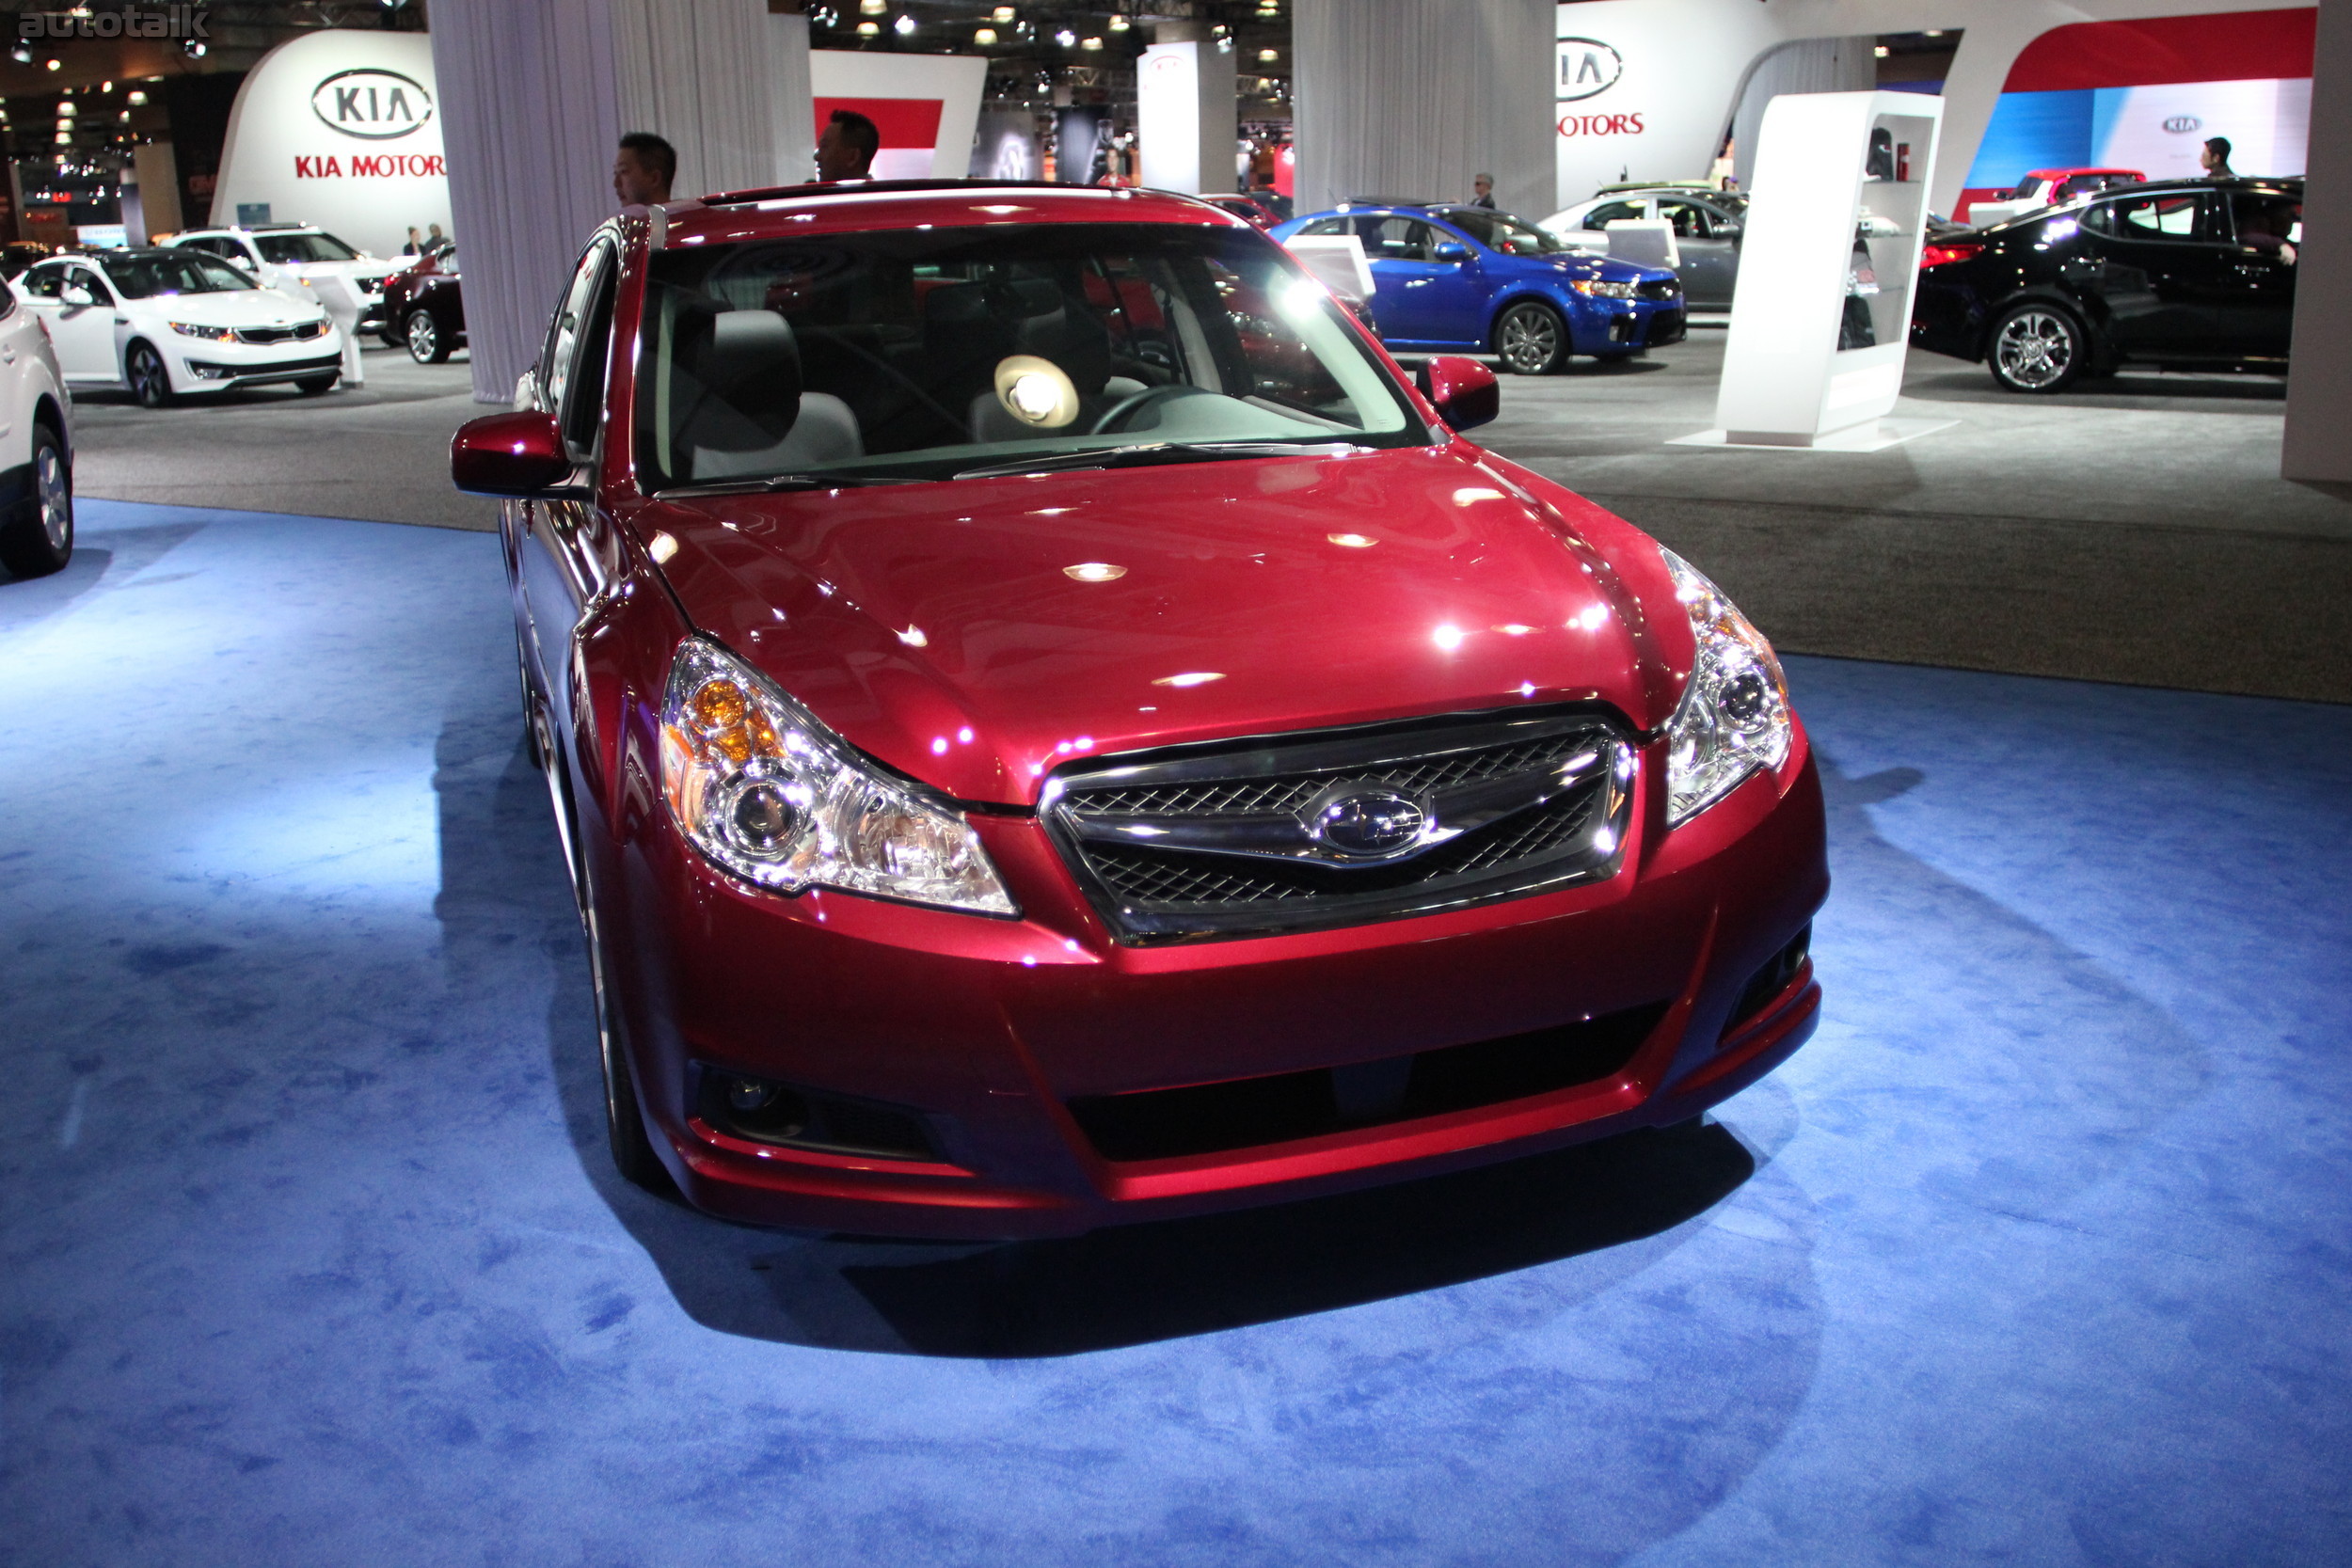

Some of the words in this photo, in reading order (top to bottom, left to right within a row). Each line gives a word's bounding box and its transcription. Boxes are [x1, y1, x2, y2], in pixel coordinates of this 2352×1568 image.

[335, 87, 413, 121] KIA
[1557, 113, 1644, 136] OTORS
[295, 156, 342, 178] KIA
